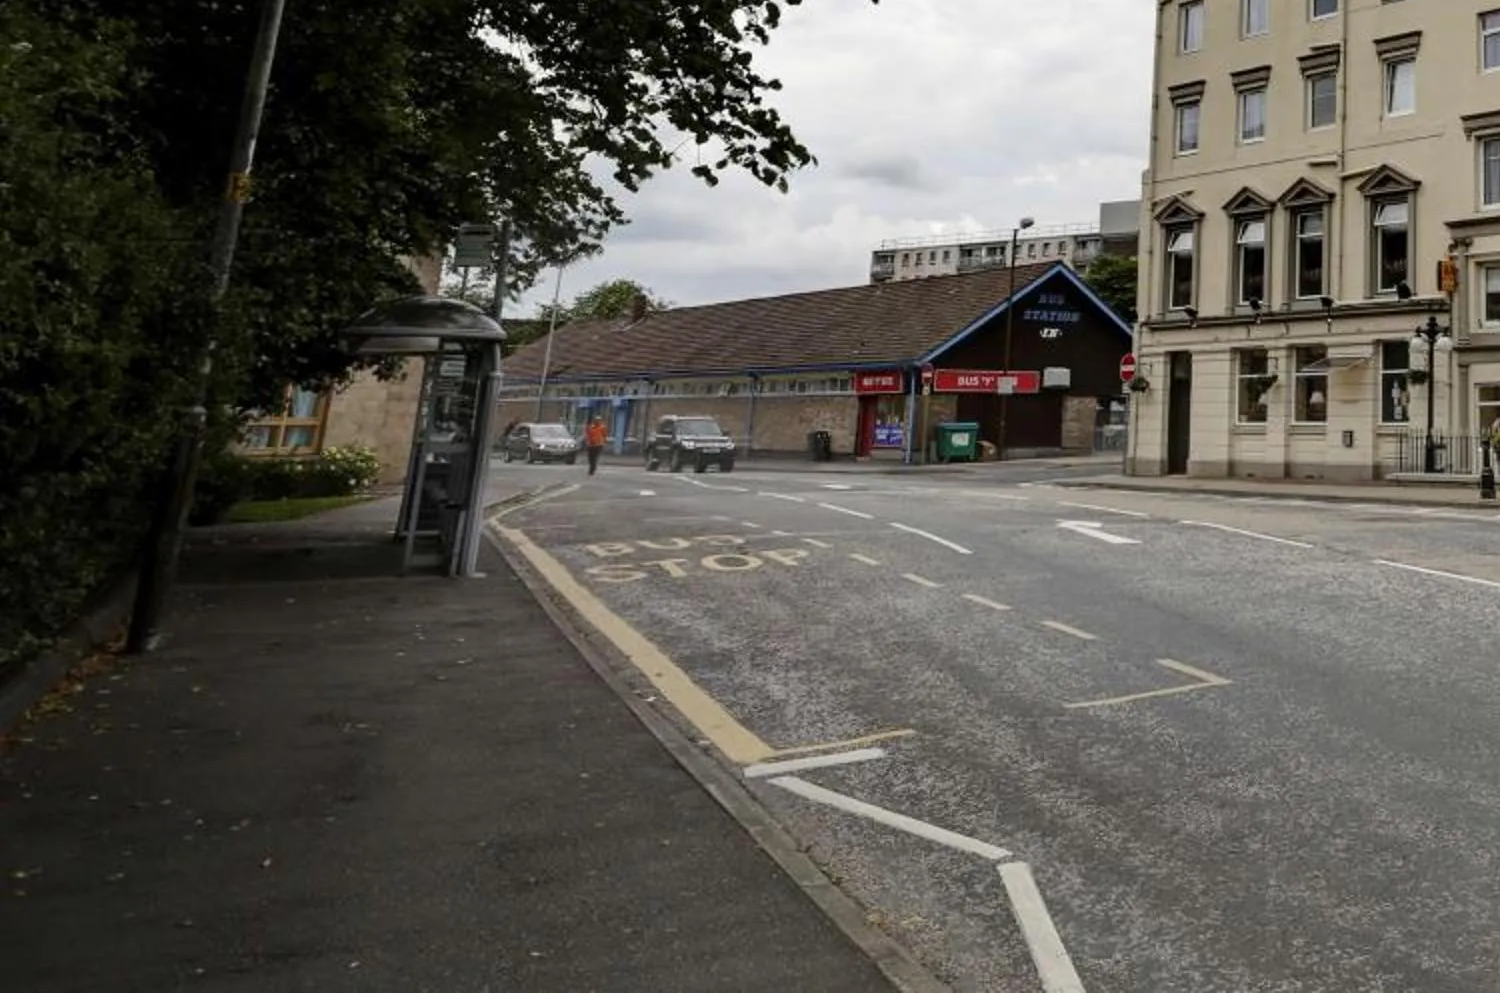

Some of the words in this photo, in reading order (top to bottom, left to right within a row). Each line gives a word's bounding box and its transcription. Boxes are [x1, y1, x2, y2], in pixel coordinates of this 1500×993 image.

[957, 375, 979, 386] BUS
[585, 534, 745, 557] BUS
[585, 548, 809, 582] STOP
